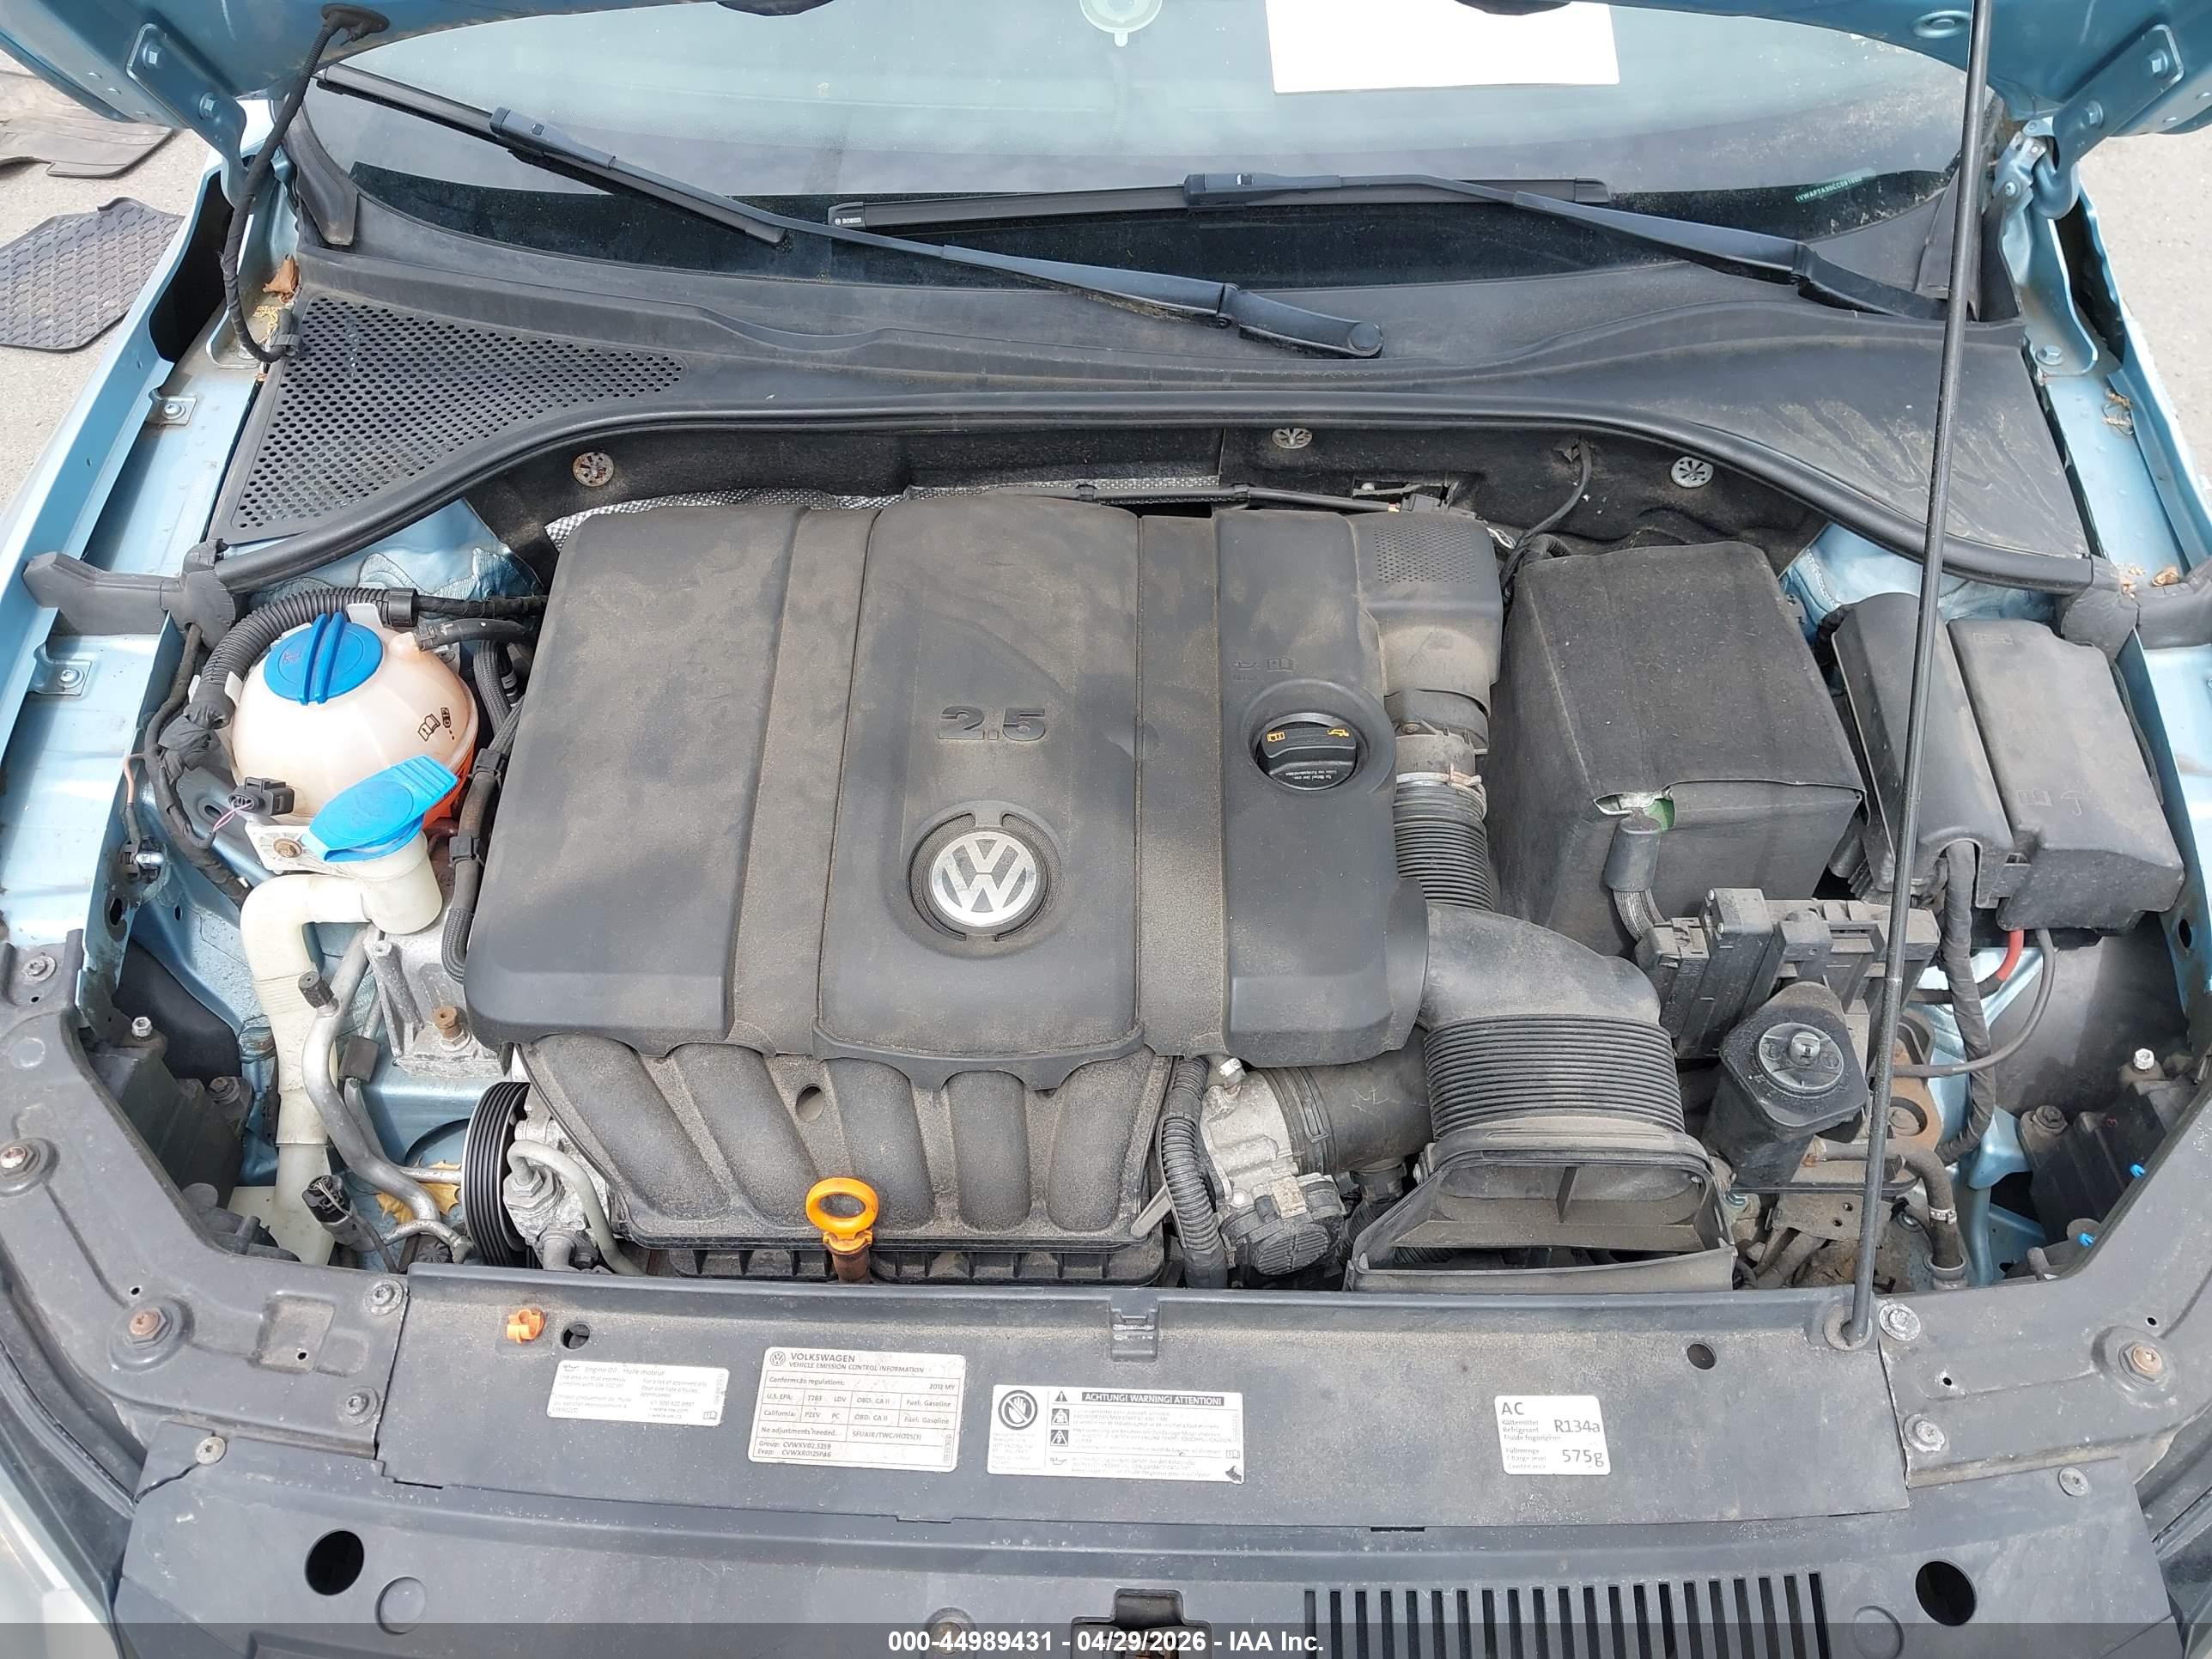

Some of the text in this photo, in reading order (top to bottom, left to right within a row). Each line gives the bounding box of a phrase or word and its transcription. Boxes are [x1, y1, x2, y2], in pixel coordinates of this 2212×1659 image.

[441, 708, 451, 727] G12
[938, 705, 1047, 741] 2.5
[790, 1352, 855, 1363] VOLKSWAGEN
[808, 1377, 846, 1387] regulations:
[1085, 1393, 1222, 1406] ACHTUNG! WARNING! ATTENTION!
[1501, 1401, 1525, 1415] AC
[772, 1427, 811, 1436] adjustments
[1553, 1419, 1601, 1433] R134a
[1562, 1449, 1604, 1468] 575g
